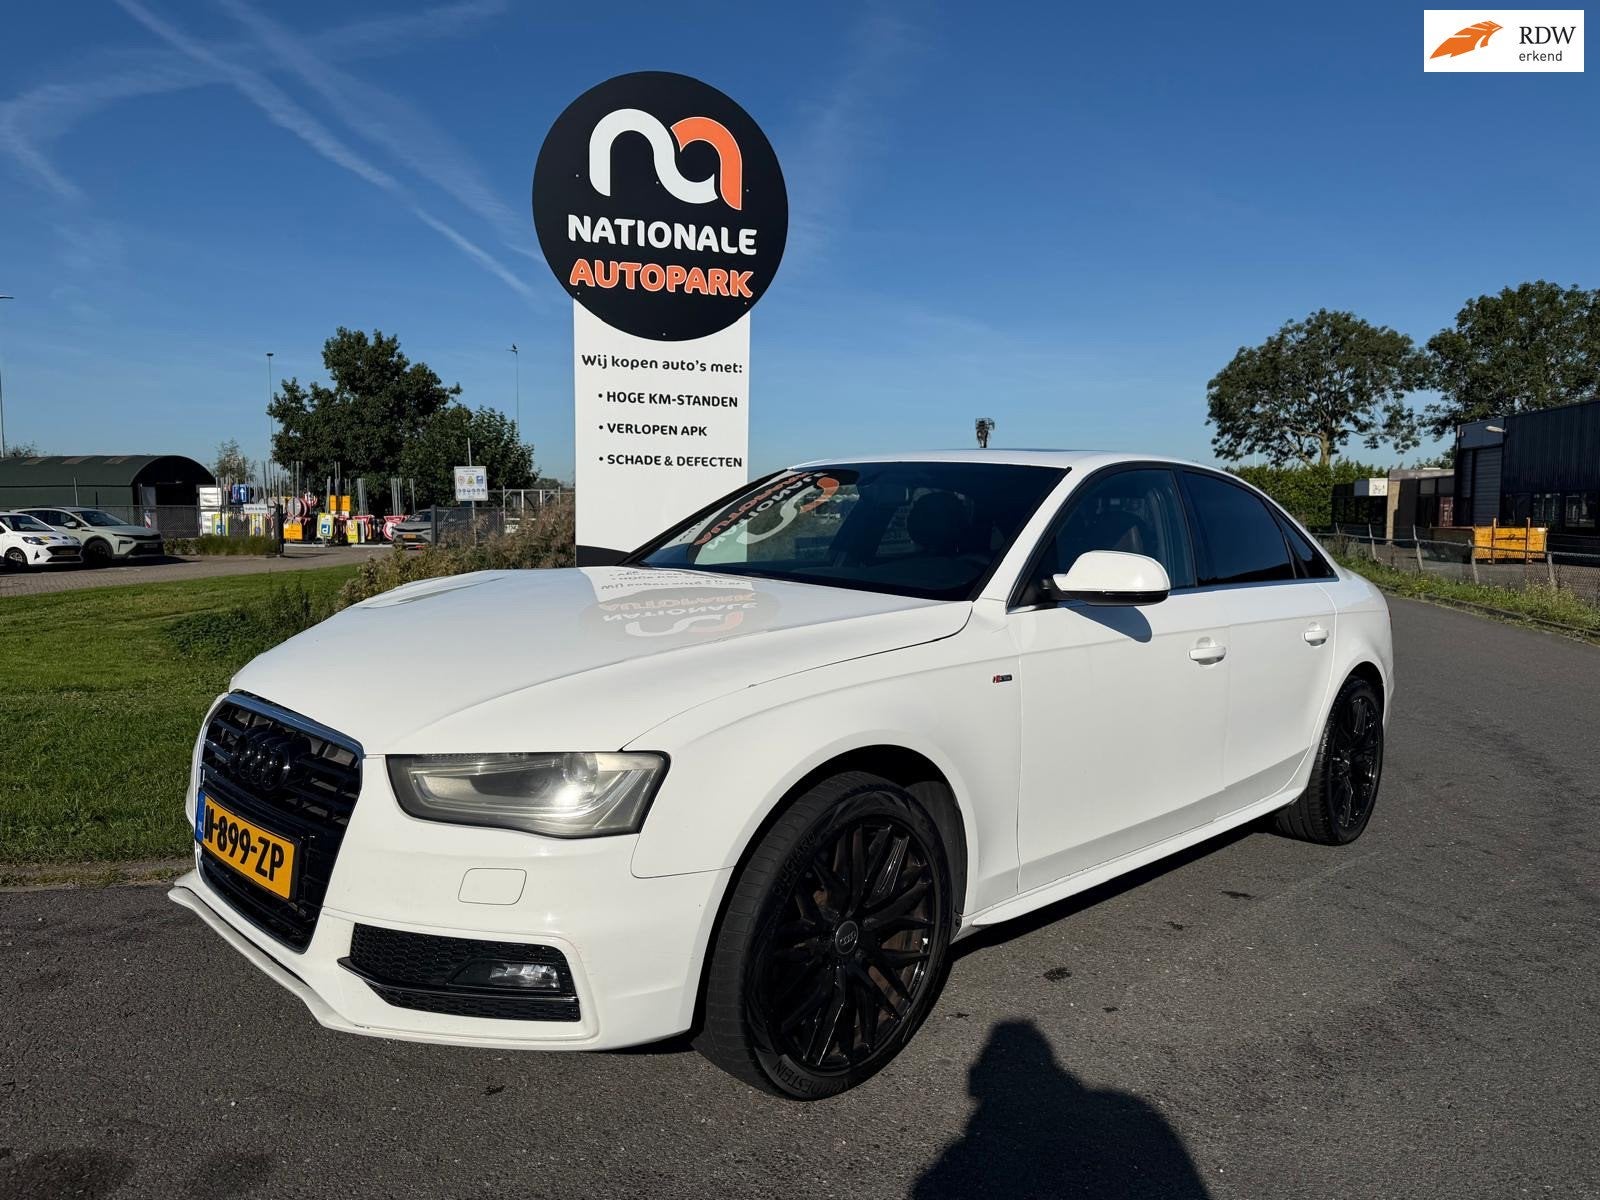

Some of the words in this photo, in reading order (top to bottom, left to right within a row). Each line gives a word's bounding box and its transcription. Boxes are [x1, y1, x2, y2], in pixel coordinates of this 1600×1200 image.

[567, 213, 758, 256] NATIONALE
[569, 258, 754, 298] AUTOPARK
[581, 354, 608, 369] Wij
[611, 355, 659, 370] kopen
[662, 359, 707, 372] auto's
[710, 362, 743, 374] met:
[606, 391, 646, 404] HOGE
[648, 393, 738, 408] KM-STANDEN
[607, 423, 678, 436] VERLOPEN
[681, 425, 708, 437] APK
[607, 454, 662, 466] SCHADE
[664, 455, 674, 467] &
[676, 455, 743, 468] DEFECTEN
[204, 804, 285, 882] N-899-ZP
